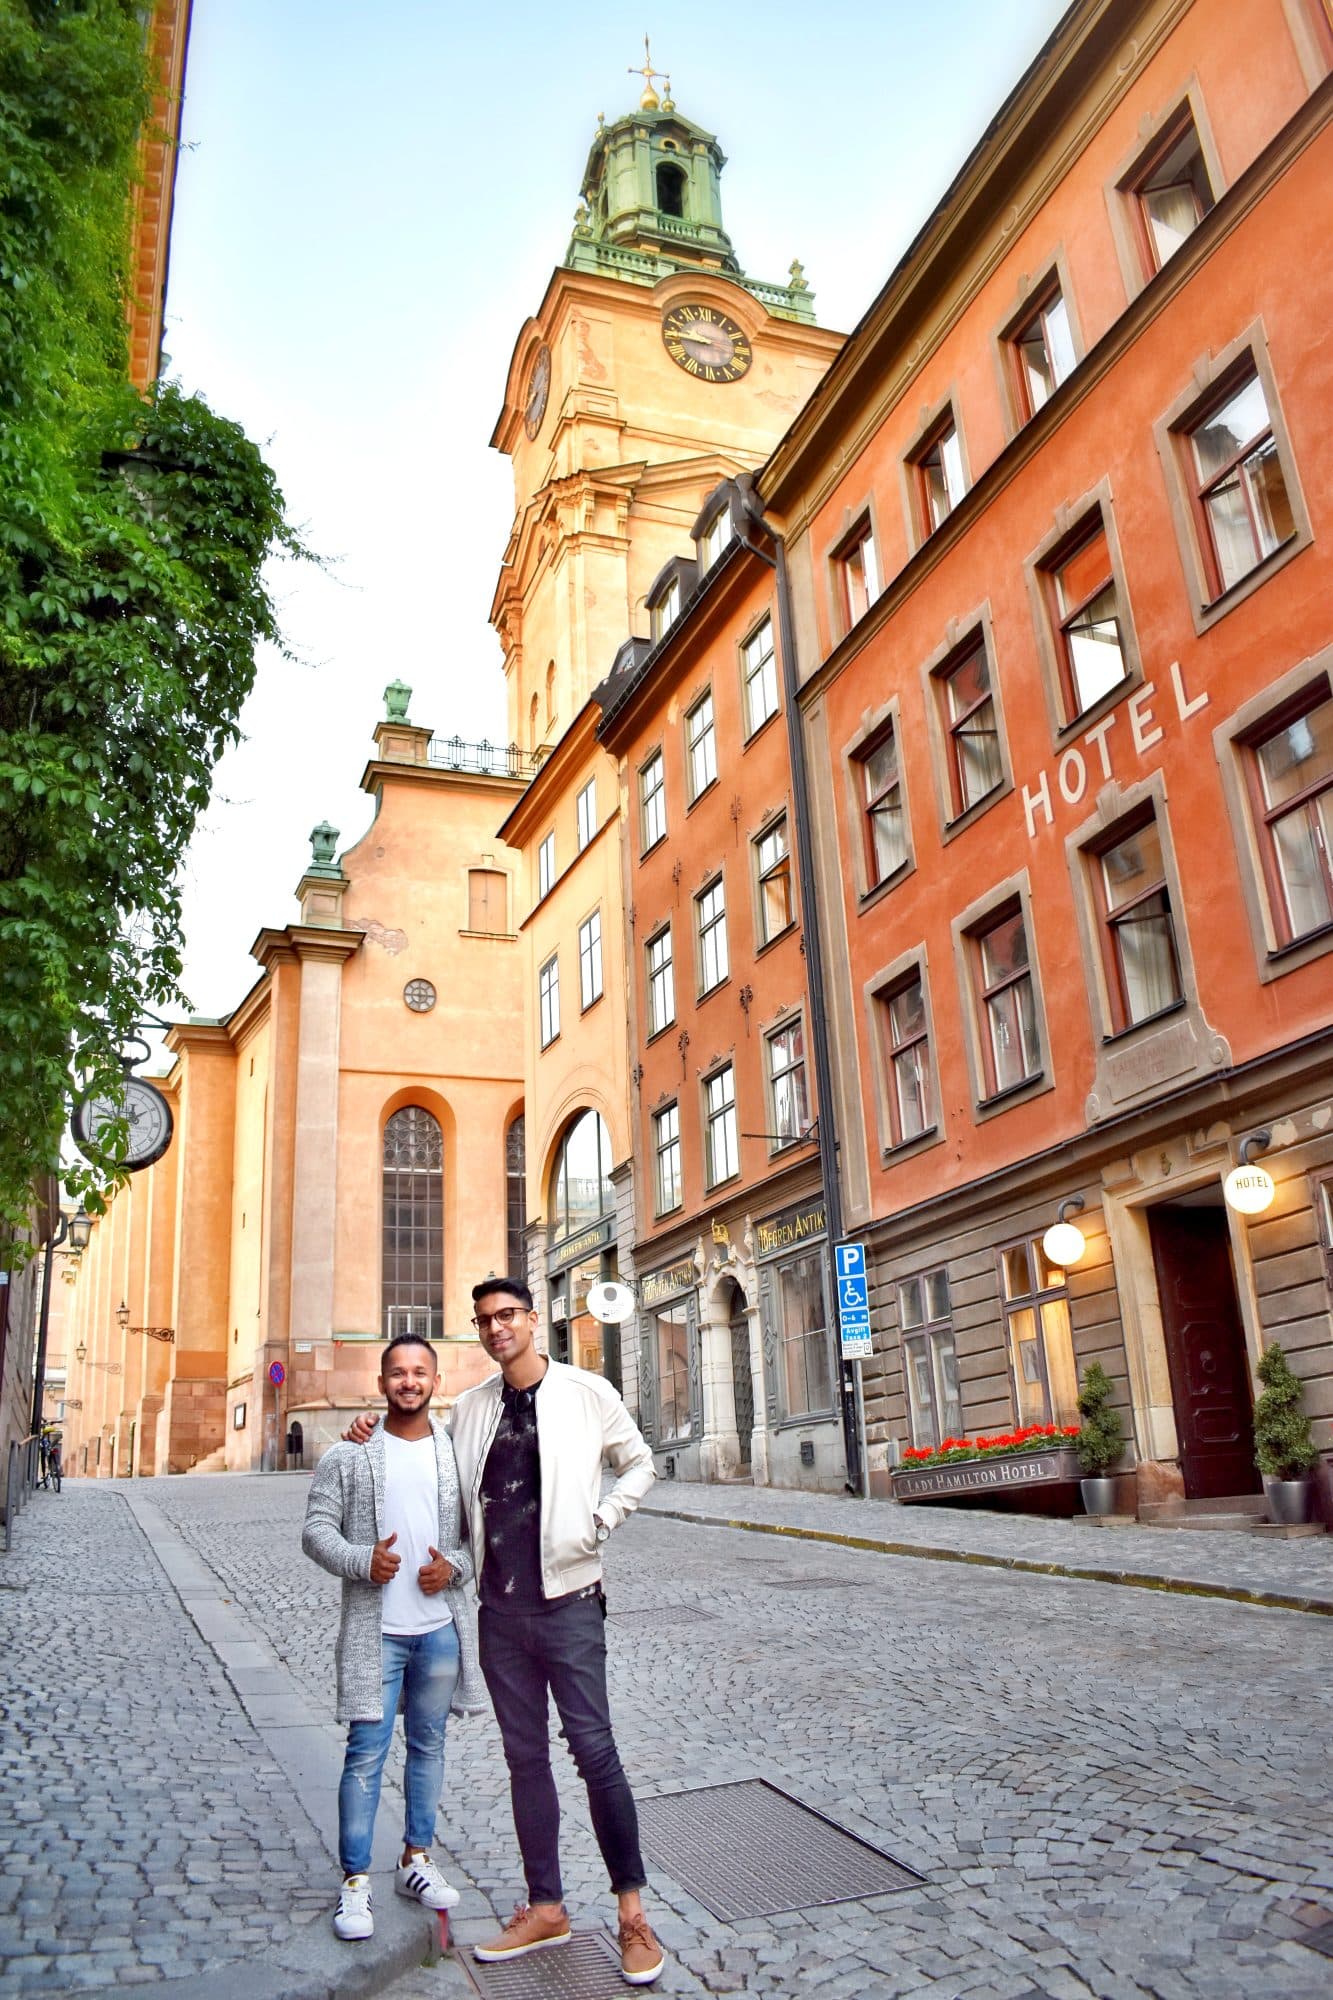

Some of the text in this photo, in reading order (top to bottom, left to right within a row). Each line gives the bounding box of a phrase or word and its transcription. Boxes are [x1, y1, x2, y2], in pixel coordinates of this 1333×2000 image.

[668, 315, 685, 327] X
[680, 306, 696, 322] XI
[698, 306, 712, 322] XII
[718, 317, 727, 328] I
[728, 331, 744, 340] II
[668, 344, 686, 360] VIII
[734, 346, 750, 356] III
[684, 358, 698, 374] VII
[705, 365, 716, 381] VI
[722, 366, 735, 380] V
[1021, 660, 1209, 839] HOTEL
[1236, 1176, 1269, 1190] HOTEL
[795, 1210, 825, 1240] ANTIK
[842, 1247, 860, 1274] P
[907, 1463, 1044, 1493] LADY HAMILTON HOTEL
